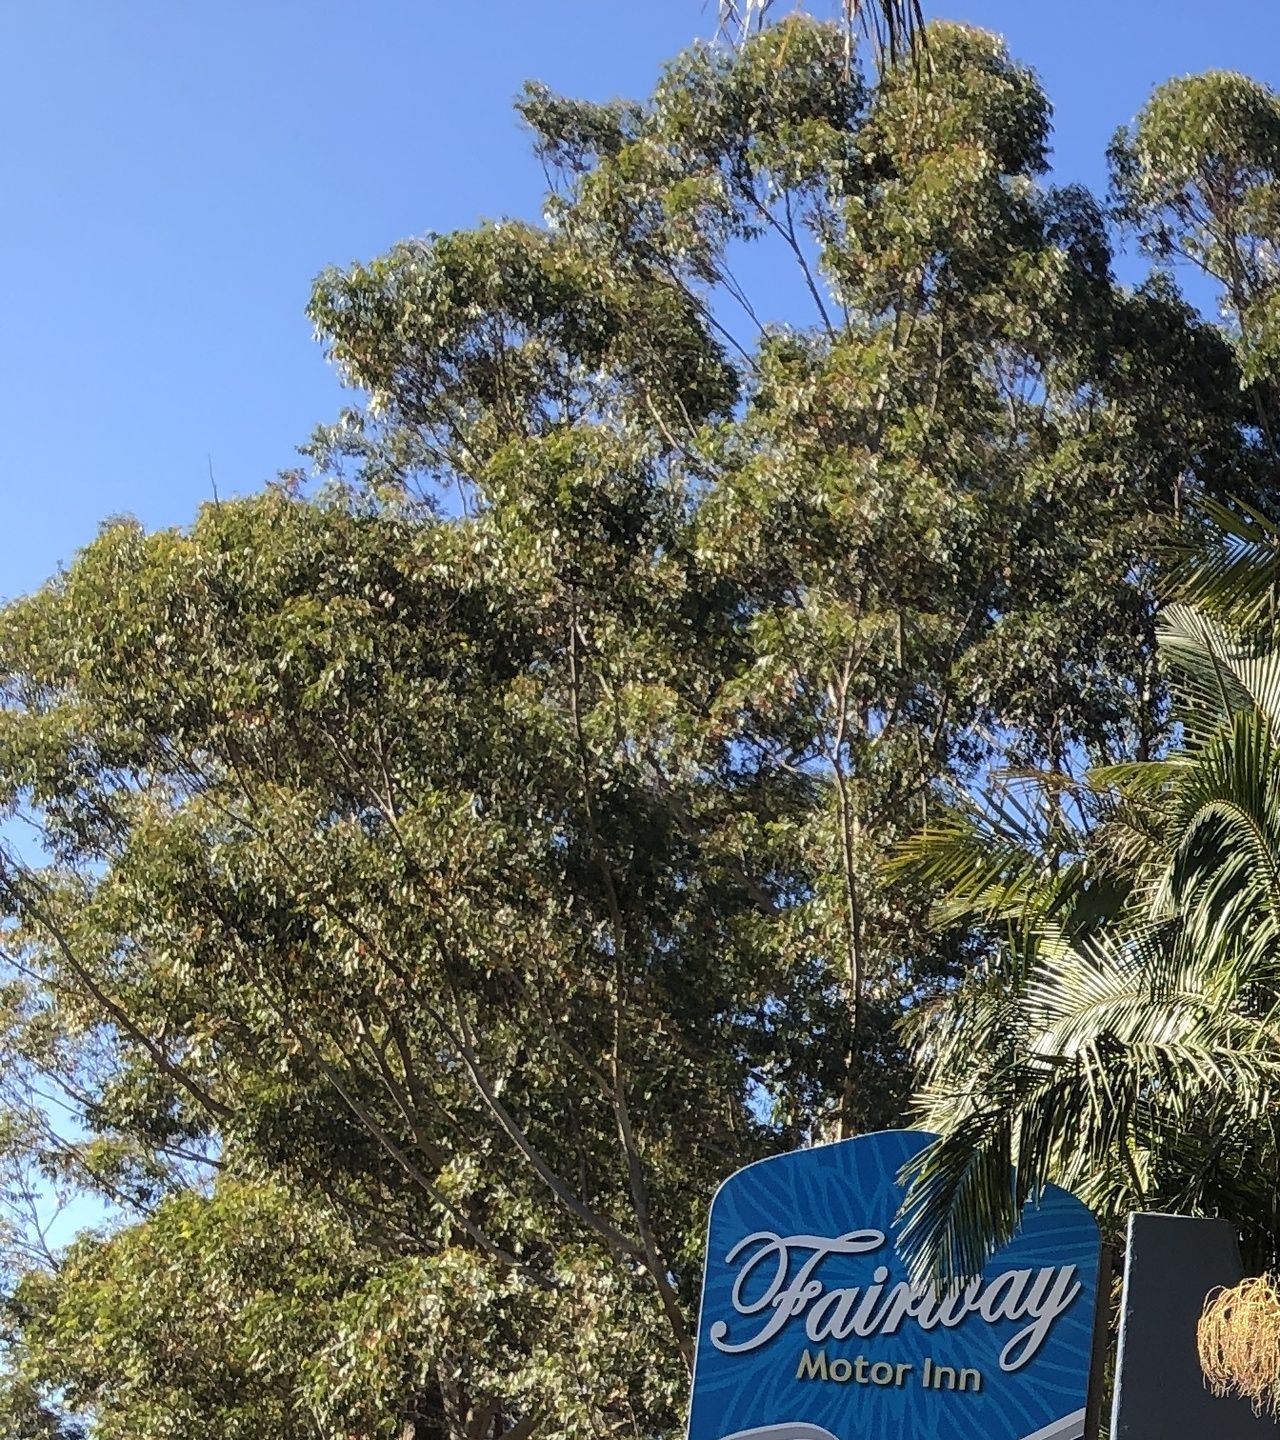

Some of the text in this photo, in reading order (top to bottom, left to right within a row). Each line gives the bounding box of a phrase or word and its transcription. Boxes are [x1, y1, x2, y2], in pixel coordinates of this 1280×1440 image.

[710, 1229, 1082, 1372] Fairway
[796, 1350, 981, 1392] Motor Inn
